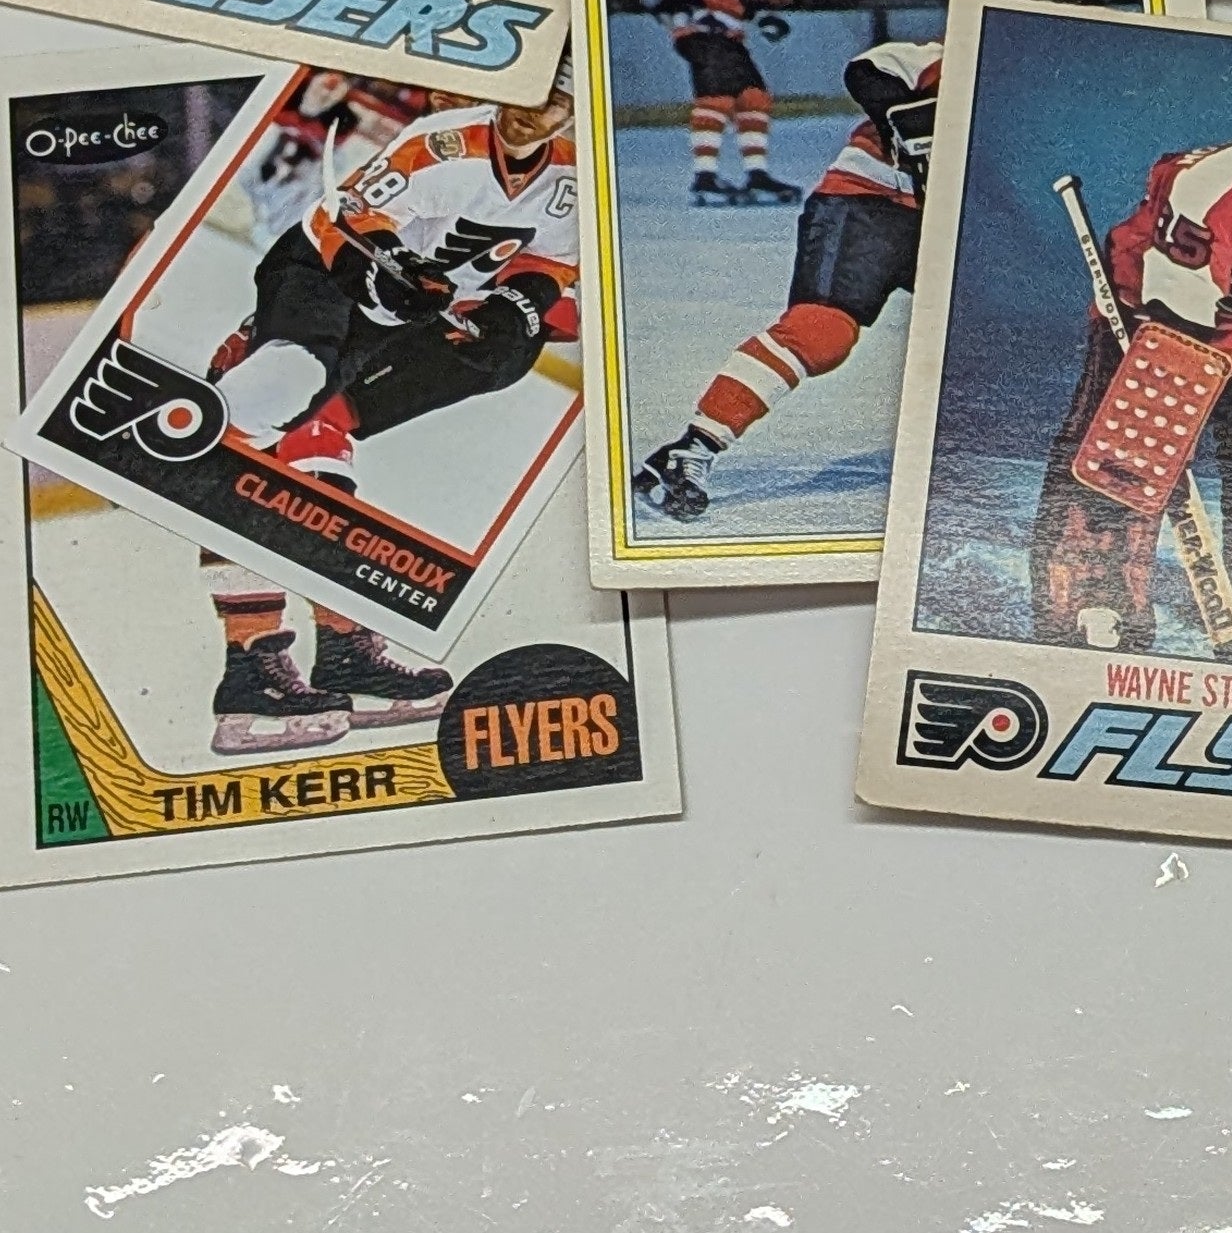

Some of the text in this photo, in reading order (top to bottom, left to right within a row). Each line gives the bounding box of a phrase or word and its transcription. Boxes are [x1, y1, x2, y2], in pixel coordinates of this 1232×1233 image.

[235, 473, 457, 595] CLAUDE GIROUX
[355, 564, 438, 613] CENTER
[1106, 663, 1193, 705] WAYNE
[462, 693, 619, 770] FLYERS
[47, 803, 90, 836] RW
[152, 765, 398, 823] TIM KERR
